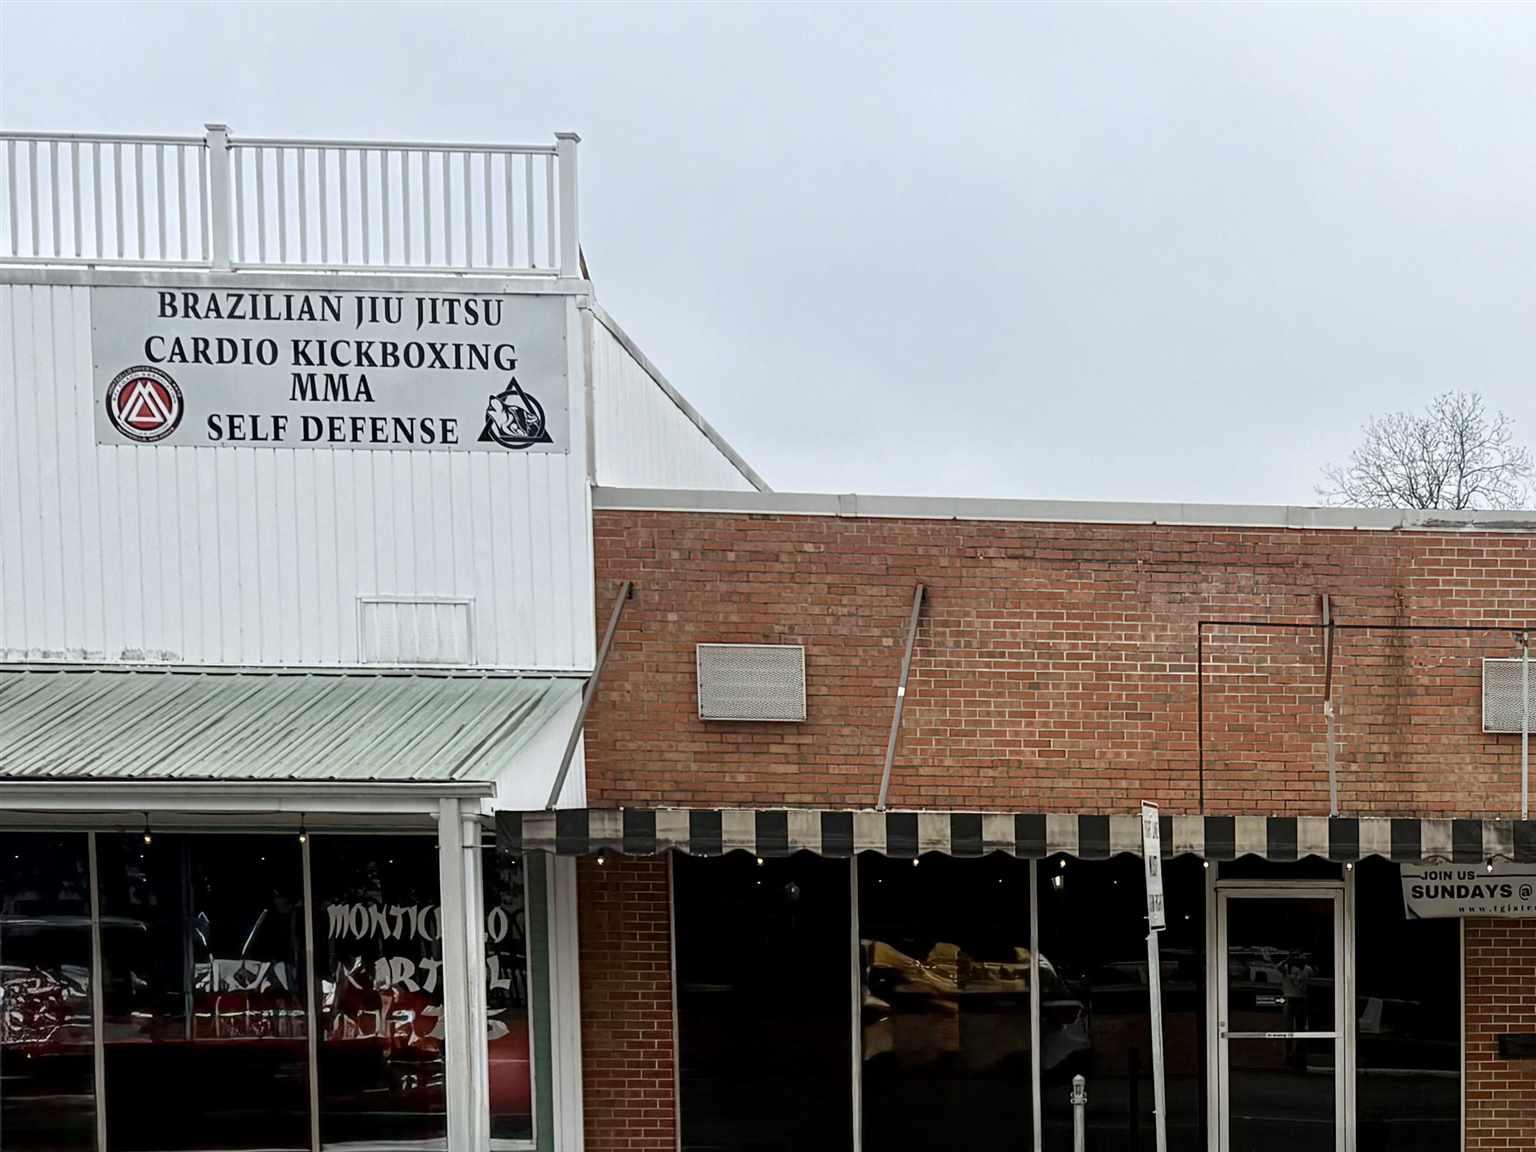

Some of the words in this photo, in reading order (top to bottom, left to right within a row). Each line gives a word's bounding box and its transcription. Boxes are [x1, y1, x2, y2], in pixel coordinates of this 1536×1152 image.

[157, 291, 343, 323] BRAZILIAN
[355, 296, 405, 330] JIU
[415, 296, 505, 332] JITSU
[144, 335, 279, 366] CARDIO
[291, 339, 518, 372] KICKBOXING
[289, 373, 376, 403] MMA
[206, 412, 289, 443] SELF
[301, 414, 460, 445] DEFENSE
[1421, 871, 1452, 881] JOIN
[1457, 871, 1475, 881] US
[1411, 884, 1513, 900] SUNDAYS
[1519, 884, 1533, 901] @
